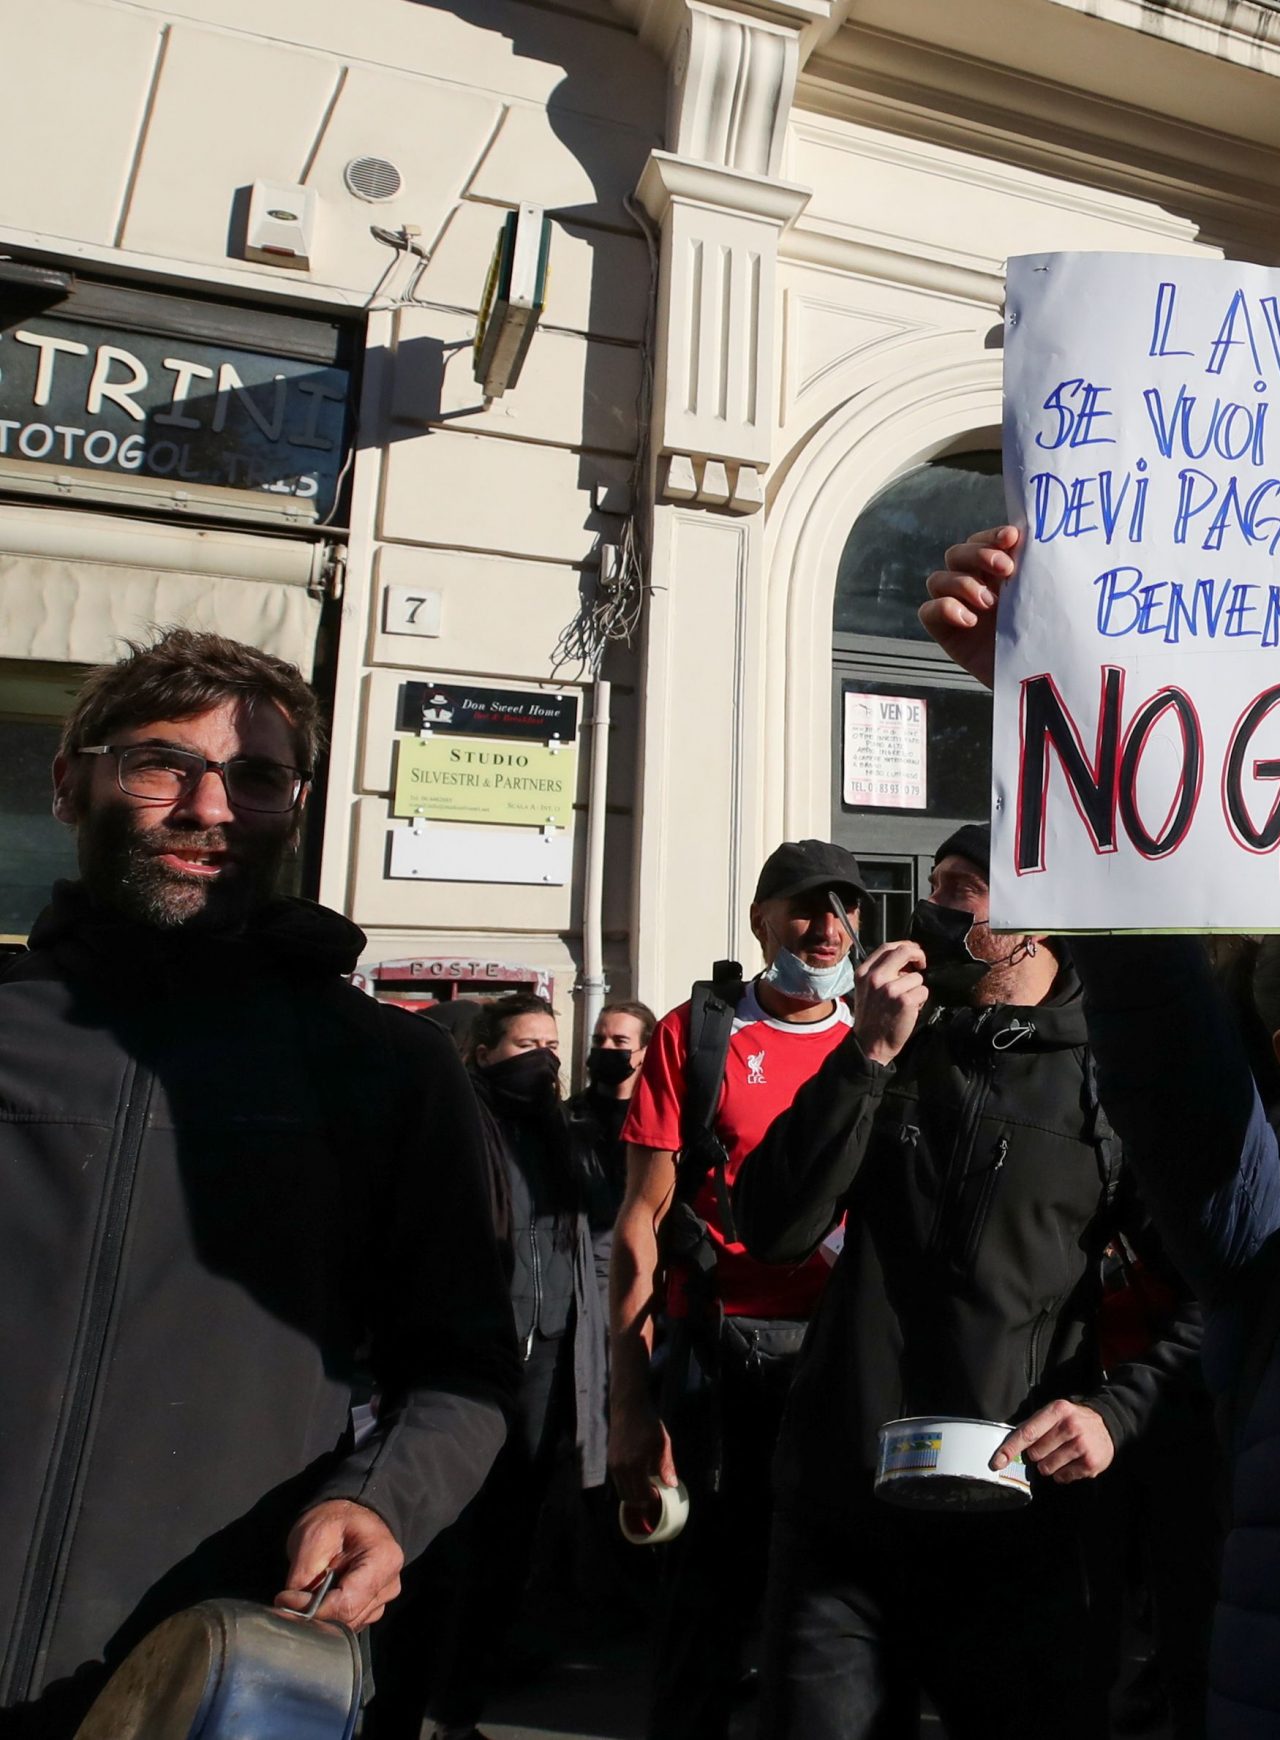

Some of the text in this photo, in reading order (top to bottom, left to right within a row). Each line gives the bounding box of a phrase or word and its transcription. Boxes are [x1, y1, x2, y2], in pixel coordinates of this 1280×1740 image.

[0, 328, 346, 452] TRINI
[1035, 378, 1117, 450] SE
[1143, 379, 1270, 466] VUOI
[1030, 457, 1150, 544] DEVI
[404, 596, 427, 624] 7
[462, 698, 561, 717] Don Sweet Home
[450, 748, 529, 768] STUDIO
[1016, 664, 1205, 877] NO
[410, 767, 563, 793] SILVESTRI & PARTNERS
[410, 961, 500, 978] POSTE
